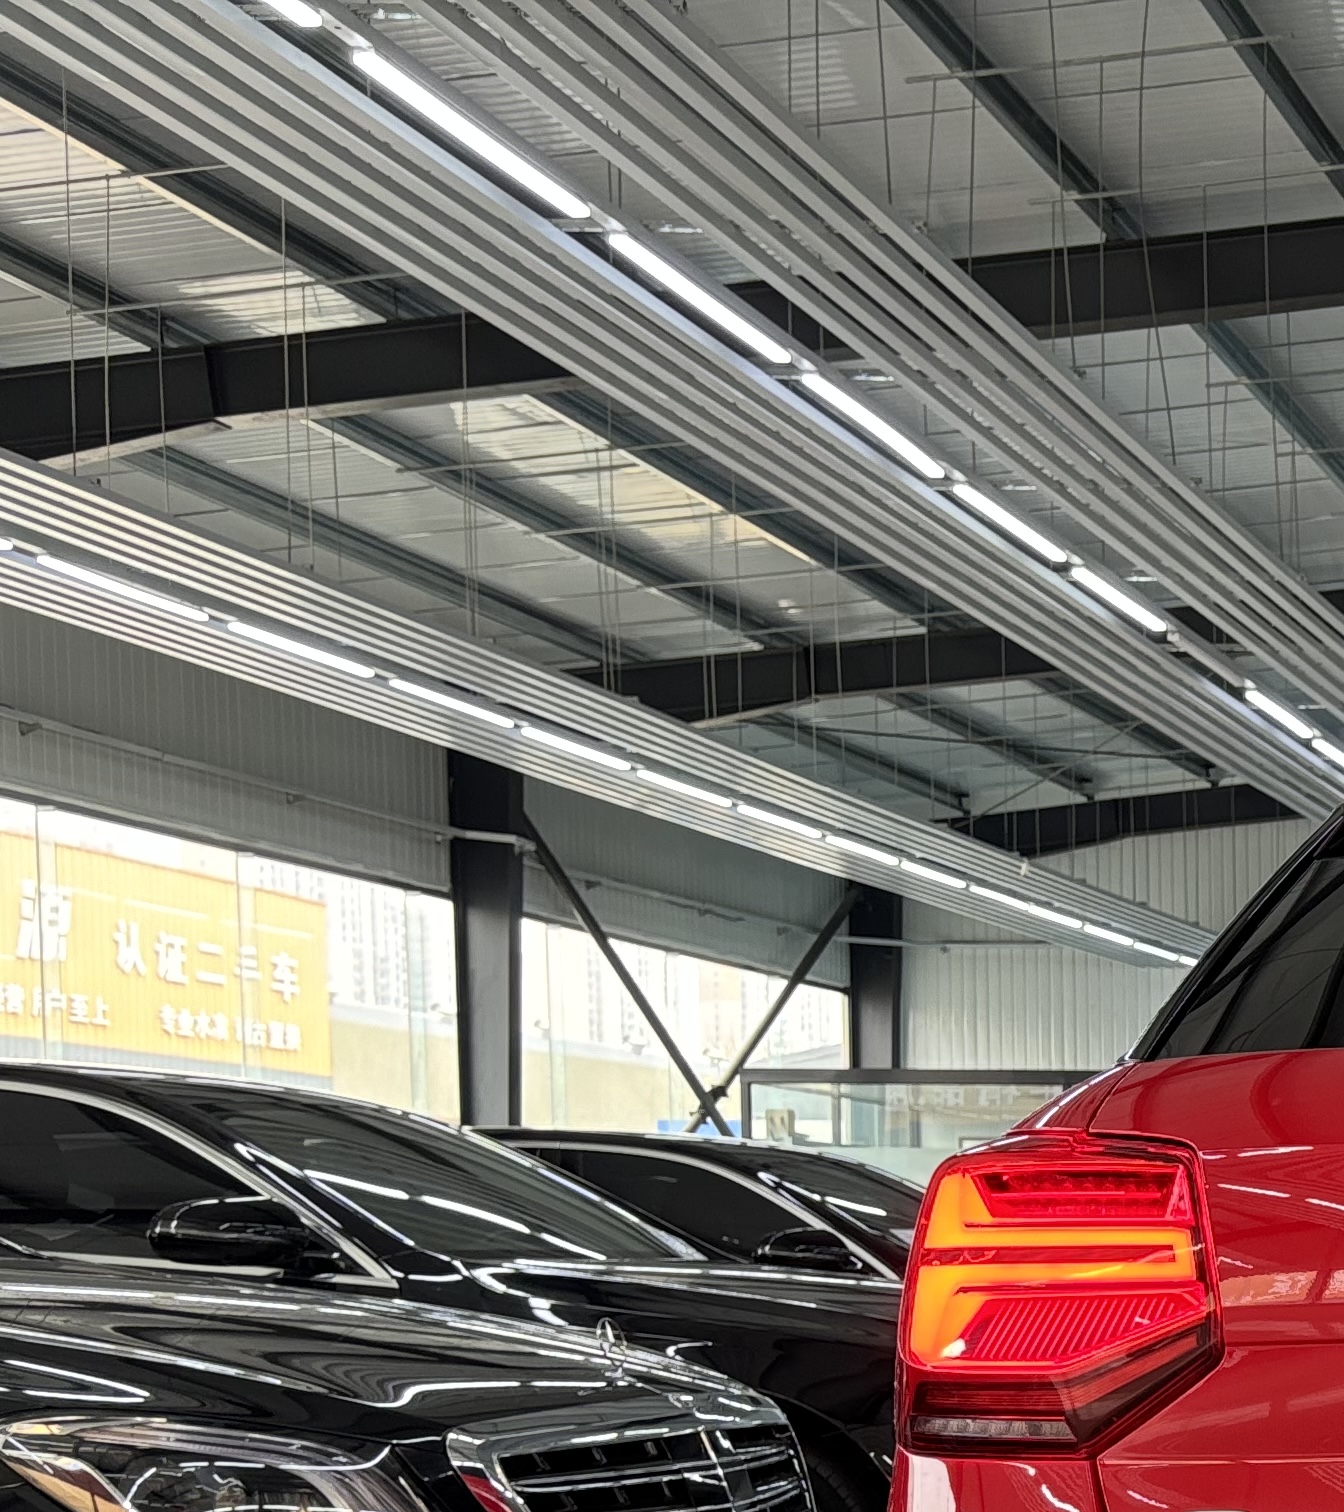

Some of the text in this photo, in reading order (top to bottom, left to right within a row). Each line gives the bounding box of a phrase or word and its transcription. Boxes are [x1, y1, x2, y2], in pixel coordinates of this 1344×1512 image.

[112, 917, 302, 1004] 认证二手车
